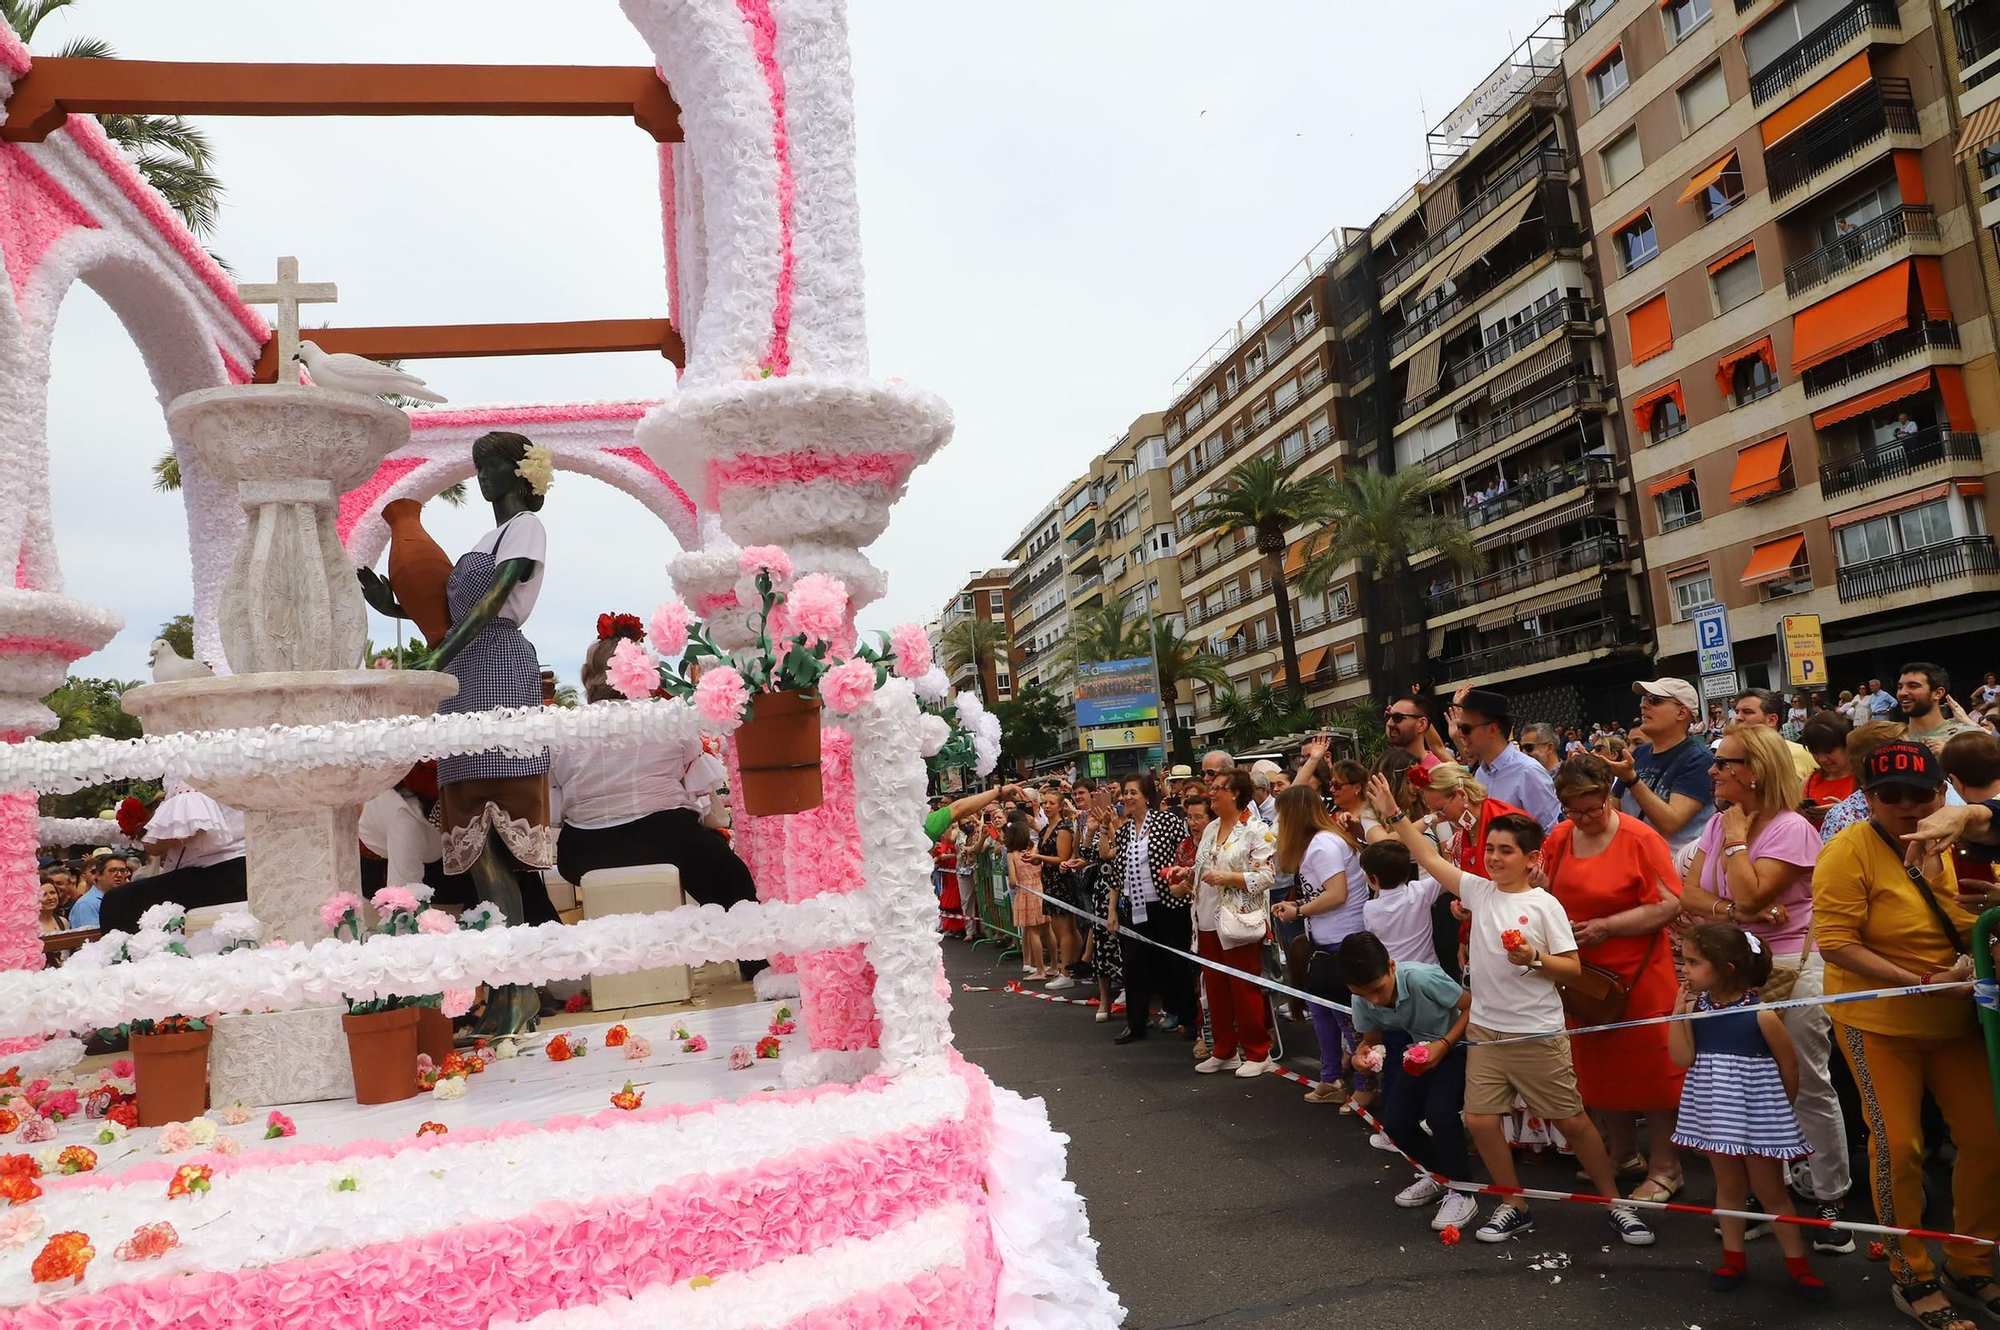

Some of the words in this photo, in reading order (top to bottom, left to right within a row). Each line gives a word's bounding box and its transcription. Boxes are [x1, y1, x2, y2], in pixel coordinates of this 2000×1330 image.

[1467, 72, 1512, 115] VRTICAL
[1704, 608, 1723, 617] ESCOLAR
[1704, 622, 1718, 646] P
[1803, 660, 1814, 680] P
[1091, 769, 1105, 778] BUS
[1871, 753, 1925, 775] ICON
